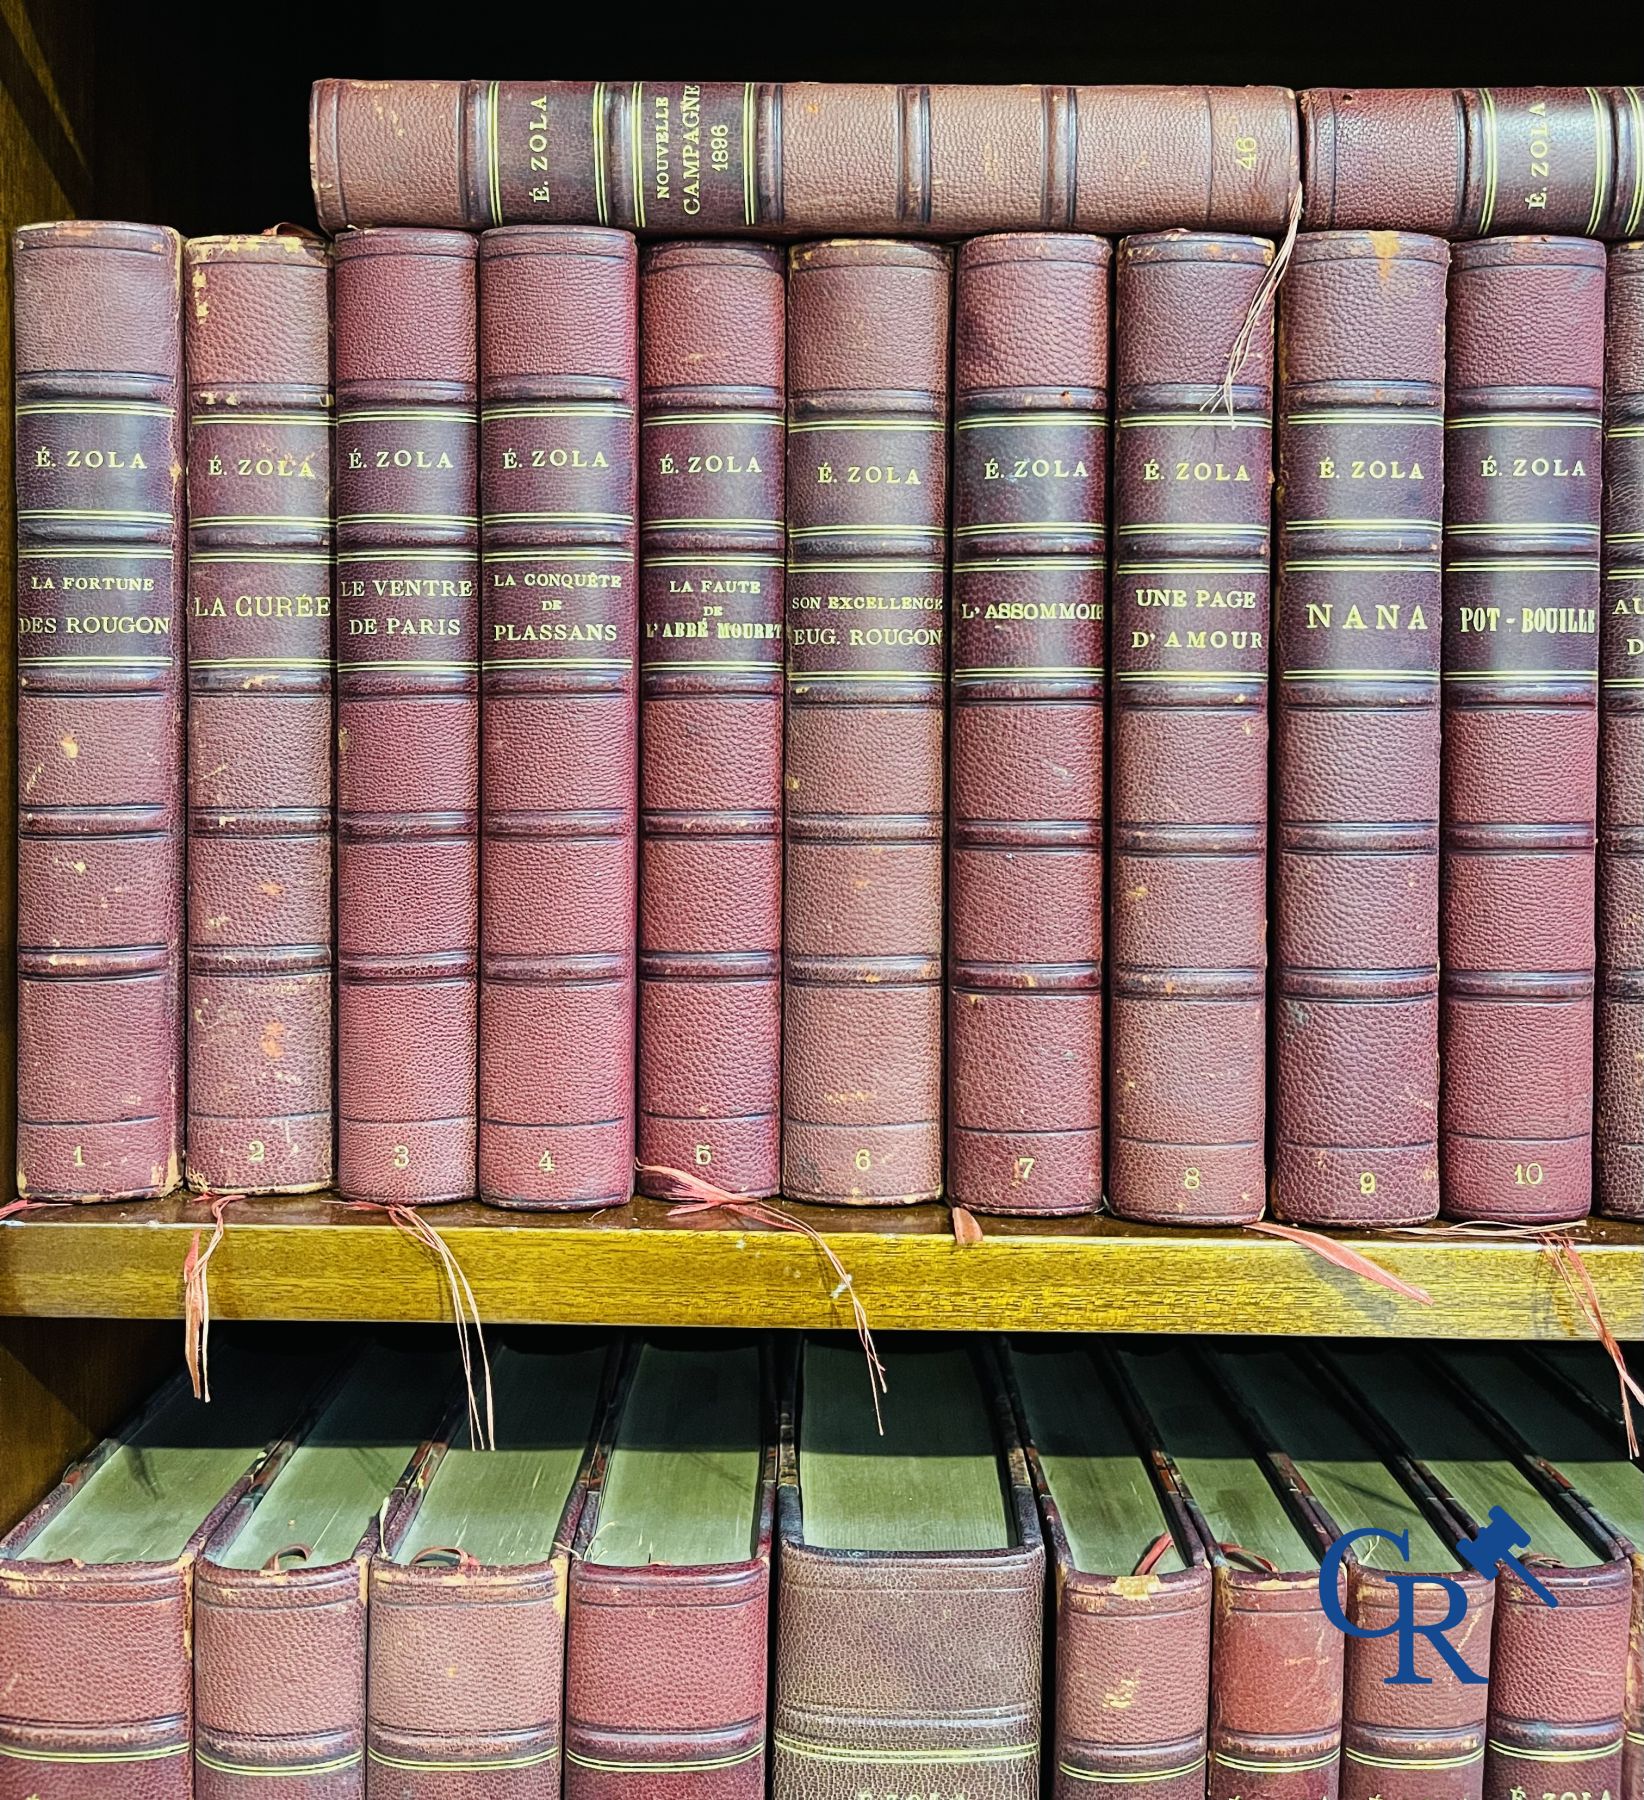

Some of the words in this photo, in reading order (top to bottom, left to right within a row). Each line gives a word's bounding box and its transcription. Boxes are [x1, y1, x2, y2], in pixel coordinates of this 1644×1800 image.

[529, 95, 548, 171] ZOLA
[1530, 102, 1549, 177] ZOLA
[656, 96, 670, 199] NOUVELLE
[682, 84, 701, 215] CAMPAGNE
[711, 124, 728, 172] 1896
[1235, 136, 1257, 170] 46
[528, 180, 550, 203] É.
[1525, 186, 1548, 210] É.
[36, 447, 56, 469] É.
[67, 451, 148, 470] ZOLA
[208, 456, 227, 475] É.
[238, 460, 315, 478] ZOLA
[348, 448, 367, 469] É.
[376, 451, 453, 469] ZOLA
[503, 448, 523, 469] É.
[532, 449, 609, 468] ZOLA
[659, 454, 679, 475] É.
[688, 456, 762, 473] ZOLA
[984, 458, 1004, 480] É.
[1014, 460, 1088, 478] ZOLA
[1319, 457, 1340, 479] É.
[1351, 461, 1424, 480] ZOLA
[1481, 455, 1502, 477] É.
[1513, 458, 1586, 477] ZOLA
[818, 463, 838, 483] É.
[848, 467, 921, 485] ZOLA
[1144, 460, 1165, 481] É.
[1176, 462, 1250, 482] ZOLA
[31, 577, 54, 590] LA
[63, 577, 155, 592] FORTUNE
[341, 581, 364, 596] LE
[375, 580, 473, 598] VENTRE
[494, 575, 516, 588] LA
[524, 572, 622, 589] CONQUÊTE
[670, 581, 693, 593] LA
[701, 581, 761, 594] FAUTE
[194, 597, 227, 617] LA
[235, 594, 331, 617] CURÉE
[542, 600, 562, 611] DE
[792, 597, 821, 609] SON
[1136, 590, 1187, 608] UNE
[1196, 590, 1256, 609] PAGE
[703, 606, 723, 616] DE
[1306, 603, 1428, 630] NANA
[19, 618, 57, 634] DES
[65, 617, 170, 634] ROUGON
[349, 619, 377, 636] DE
[387, 618, 461, 636] PARIS
[494, 624, 617, 642] PLASSANS
[717, 623, 782, 639] MOURET
[793, 628, 841, 645] EUG.
[850, 629, 942, 646] ROUGON
[73, 1146, 86, 1167] 1
[248, 1141, 266, 1162] 2
[394, 1145, 410, 1168] 3
[538, 1151, 556, 1172] 4
[695, 1145, 712, 1166] 5
[855, 1149, 871, 1171] 6
[1018, 1157, 1035, 1179] 7
[1184, 1167, 1200, 1189] 8
[1514, 1162, 1543, 1186] 10
[1359, 1172, 1376, 1194] 9
